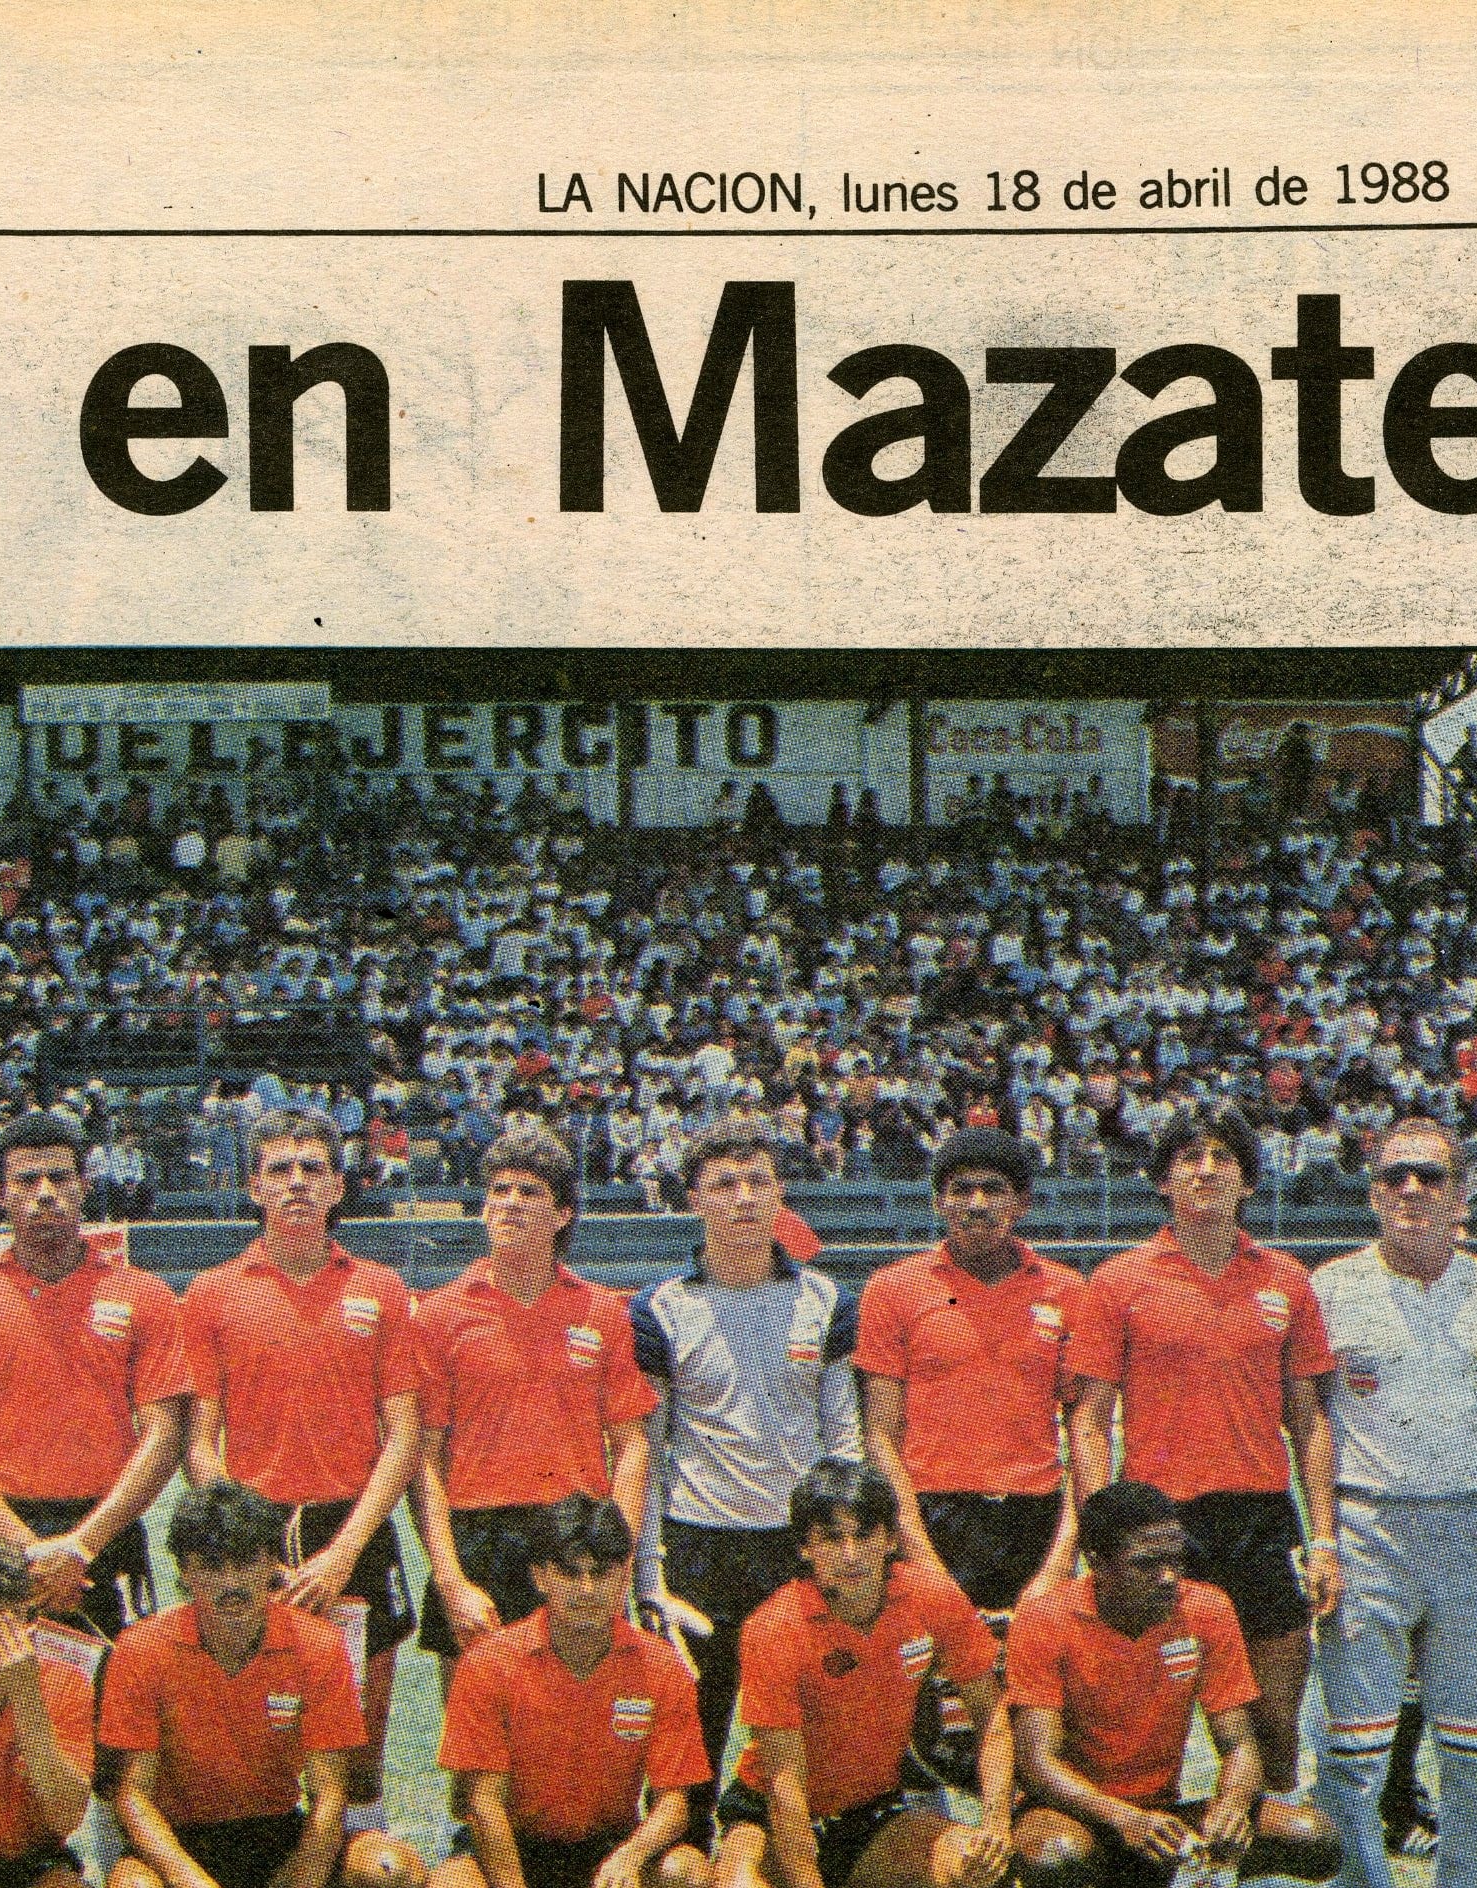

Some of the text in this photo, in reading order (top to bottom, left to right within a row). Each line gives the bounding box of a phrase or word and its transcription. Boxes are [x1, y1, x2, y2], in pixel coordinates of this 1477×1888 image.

[539, 161, 1449, 219] LA NACION, lunes 18 de abril de 1988
[80, 342, 390, 516] en
